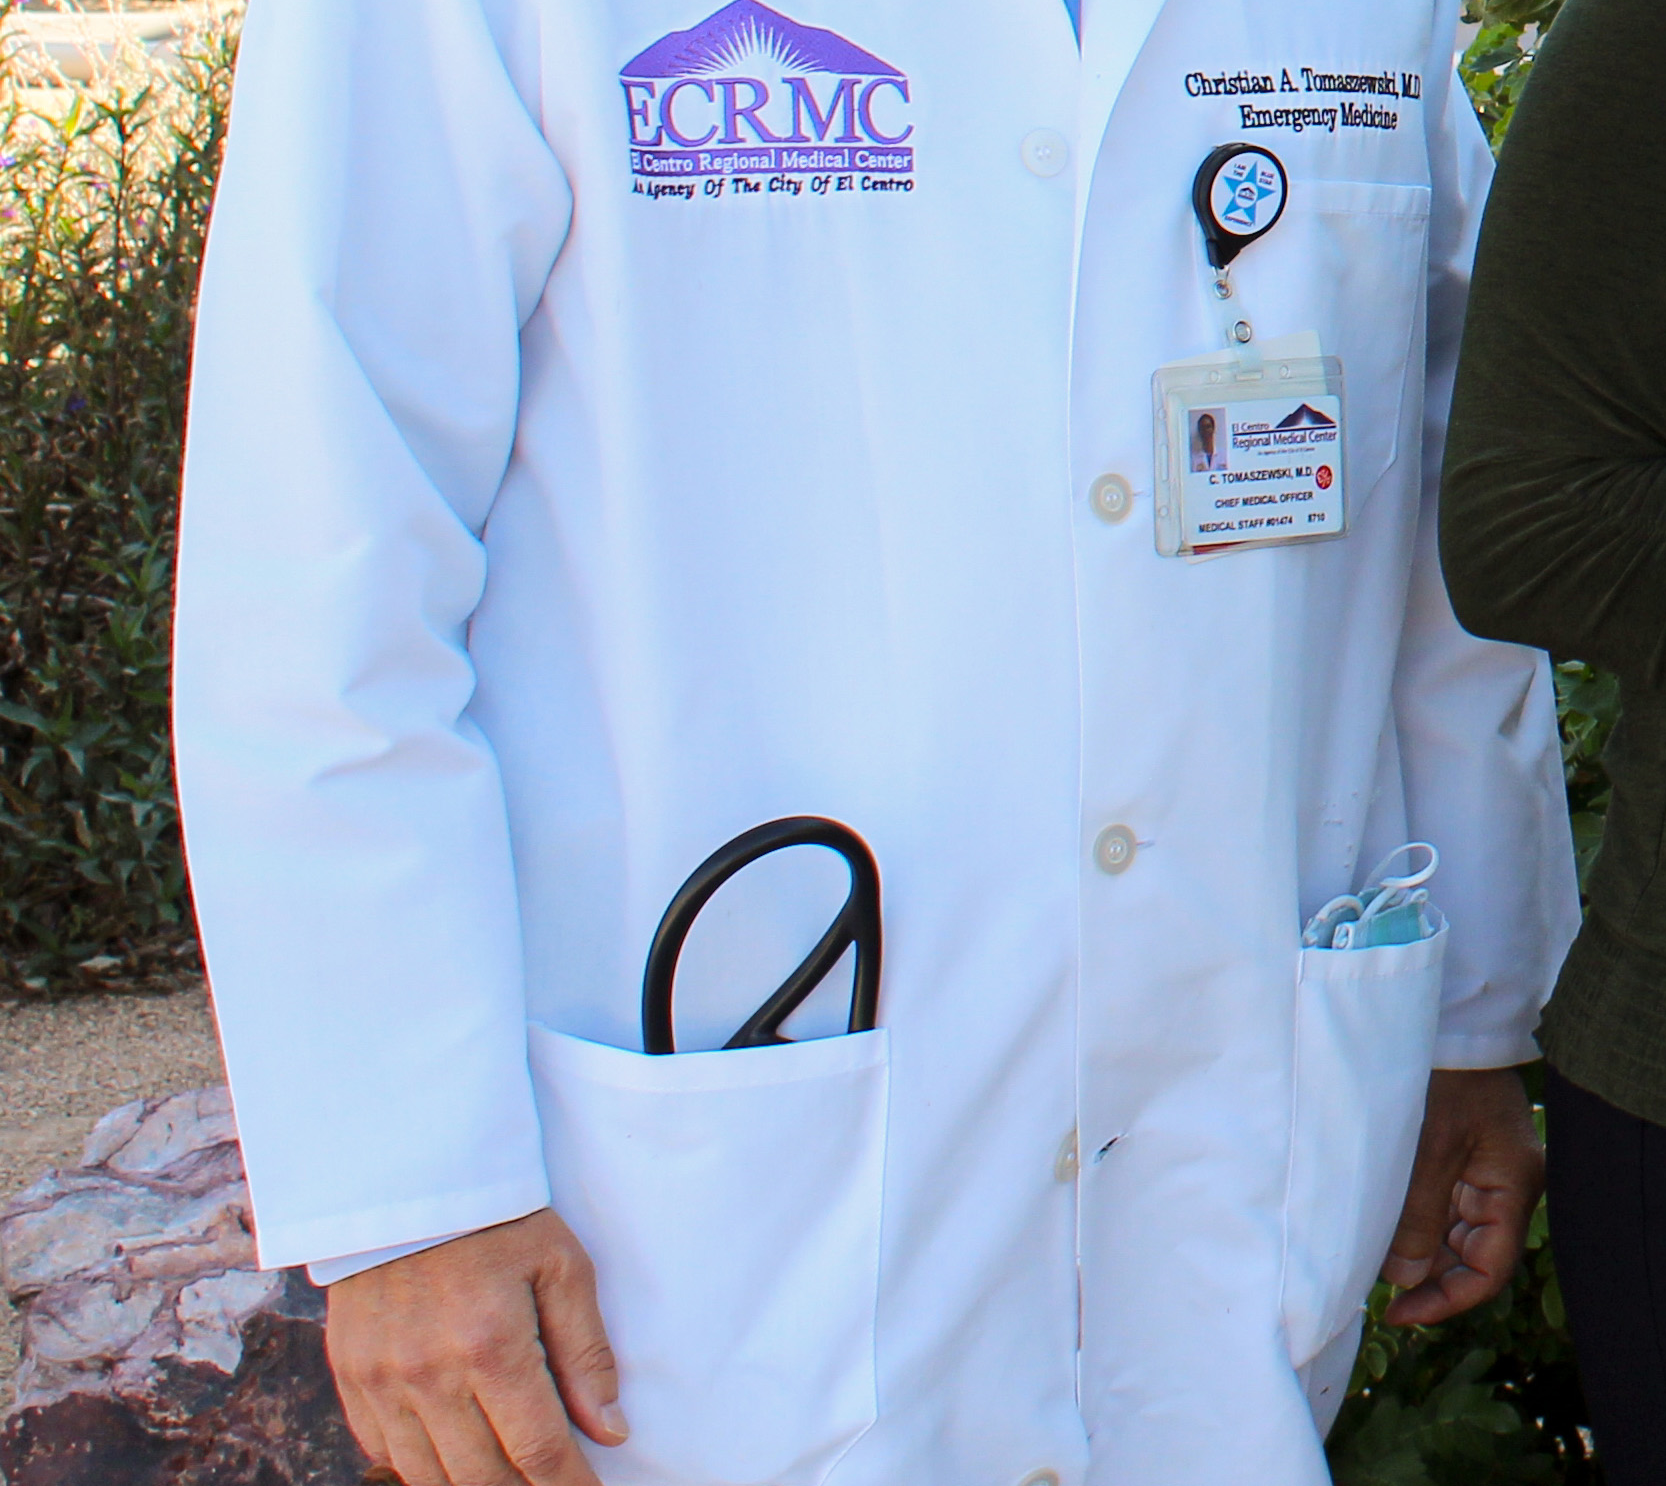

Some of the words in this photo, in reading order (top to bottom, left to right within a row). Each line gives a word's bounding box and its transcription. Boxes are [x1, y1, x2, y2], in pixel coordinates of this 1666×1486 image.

[1185, 70, 1275, 97] Christian
[1279, 67, 1299, 93] A.
[1301, 67, 1399, 100] Tomaszewski,
[620, 77, 914, 147] ECRMC
[1239, 104, 1338, 133] Emergency
[1340, 102, 1398, 130] Medicine
[643, 153, 694, 173] Centro
[698, 148, 776, 174] Regional
[782, 148, 850, 169] Medical
[855, 150, 912, 169] Center
[647, 180, 695, 199] Agency
[704, 177, 725, 198] Of
[731, 177, 761, 194] The
[768, 173, 803, 196] City
[812, 174, 832, 195] Of
[836, 175, 854, 192] El
[861, 175, 914, 192] Centro
[1232, 423, 1239, 432] El
[1241, 422, 1270, 432] Centro
[1232, 434, 1271, 452] Regional
[1273, 431, 1306, 445] Medical
[1308, 430, 1337, 442] Center
[1209, 474, 1219, 485] C.
[1222, 469, 1293, 485] TOMASZEWSKI,
[1215, 497, 1240, 508] CHIEF
[1242, 494, 1278, 506] MEDICAL
[1280, 491, 1314, 503] OFFICER
[1199, 520, 1236, 533] MEDICAL
[1238, 518, 1264, 529] STAFF
